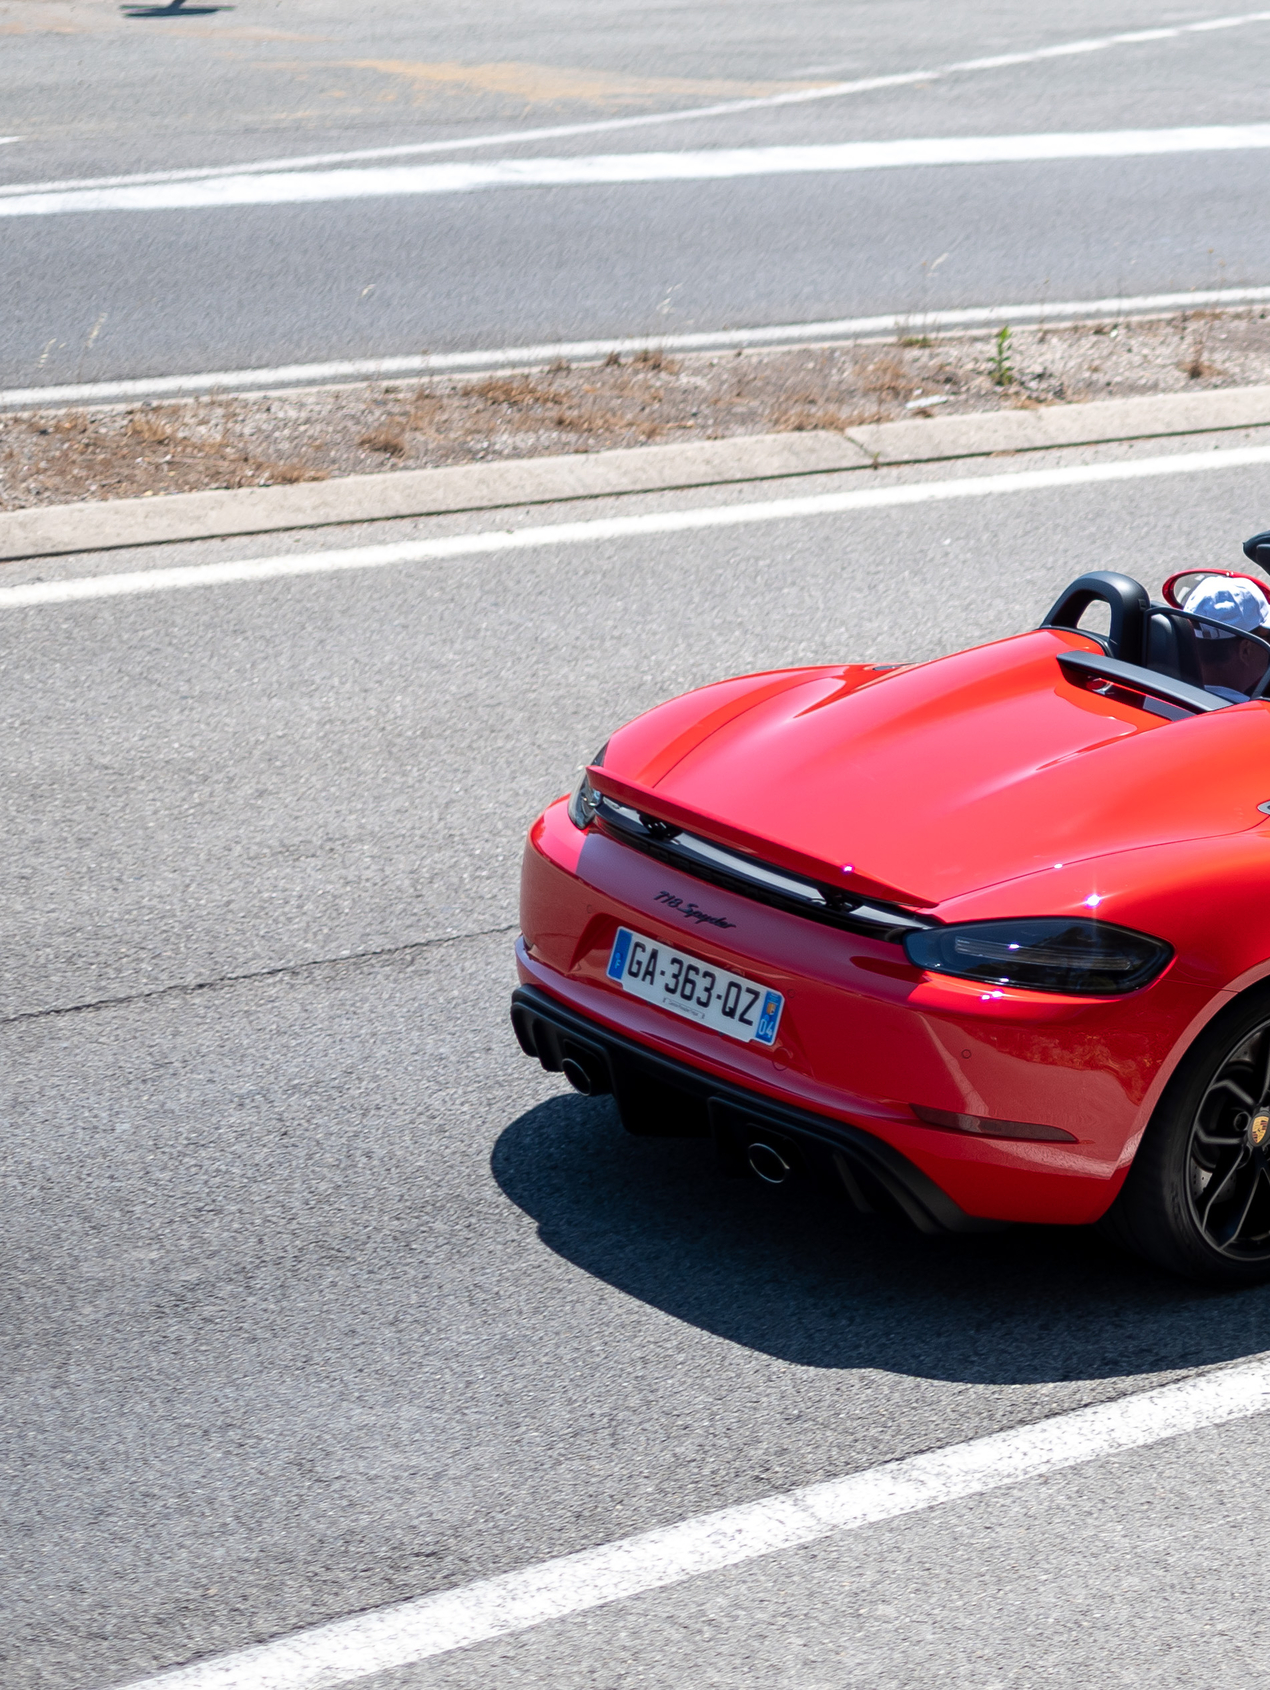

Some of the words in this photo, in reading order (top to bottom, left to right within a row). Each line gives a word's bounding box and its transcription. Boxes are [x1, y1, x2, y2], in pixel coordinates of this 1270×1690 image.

[653, 890, 683, 908] 718
[677, 903, 737, 929] Spyder
[758, 1018, 774, 1038] 04
